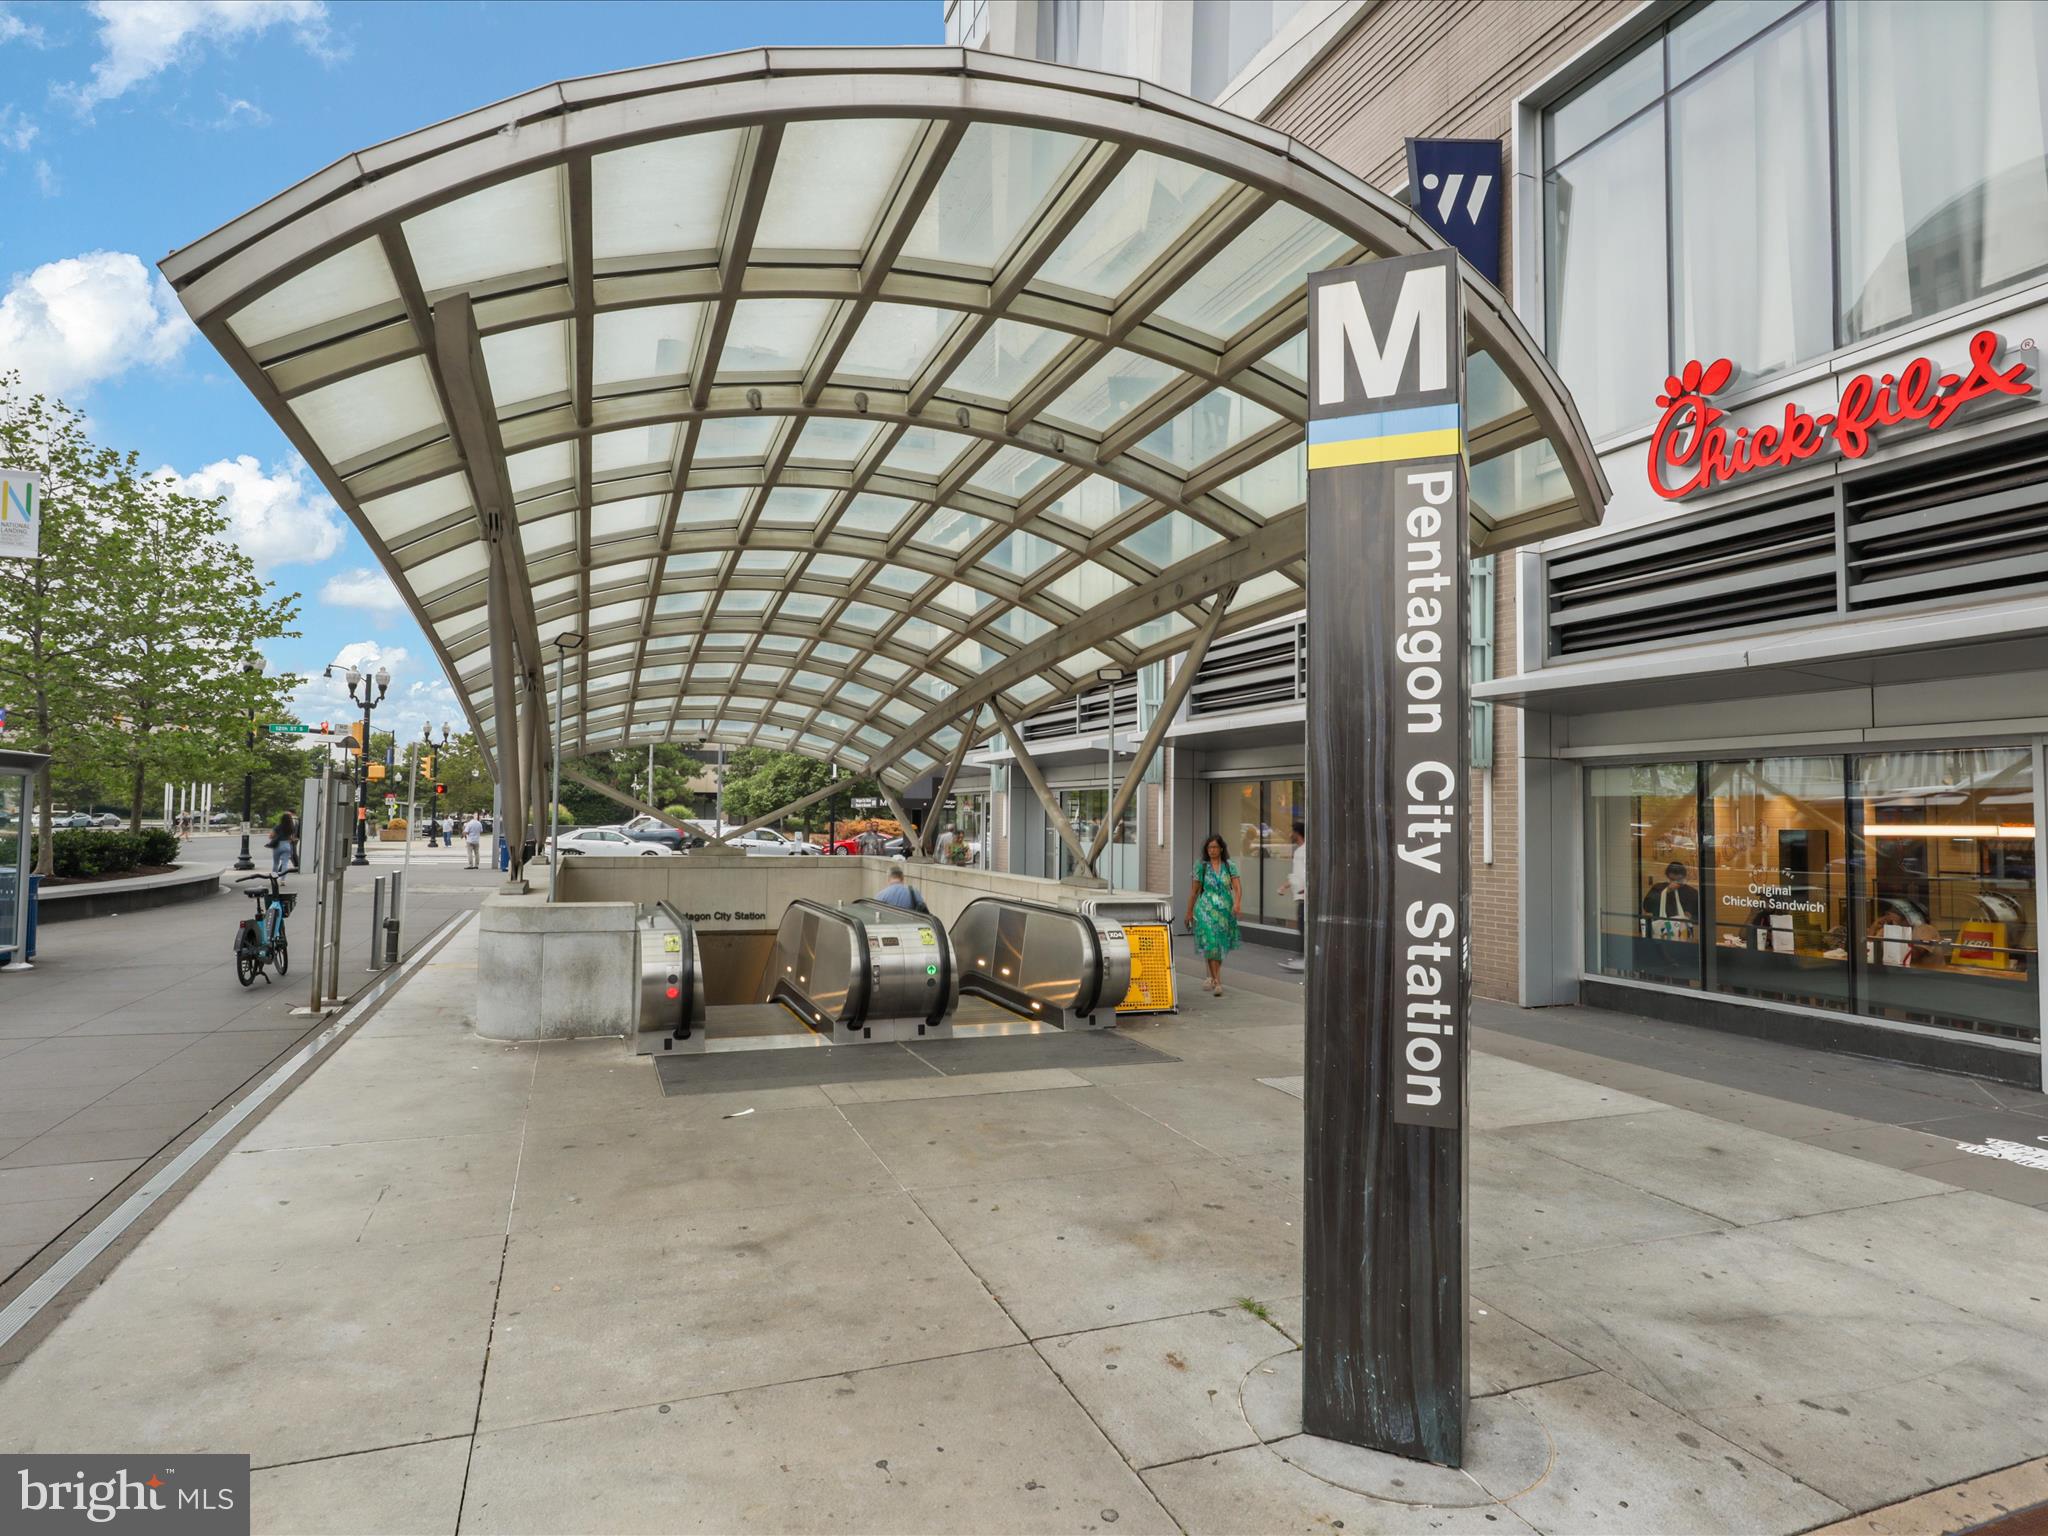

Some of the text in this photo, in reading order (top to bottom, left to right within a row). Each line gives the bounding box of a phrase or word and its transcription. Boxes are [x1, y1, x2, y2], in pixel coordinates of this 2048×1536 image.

[1318, 265, 1447, 405] M
[1647, 331, 2032, 499] Chick-fil-A
[1396, 470, 1455, 1106] Pentagon City Station
[683, 911, 766, 922] tagon City Station
[1722, 895, 1824, 913] Chicken Sandwich
[1748, 883, 1792, 897] Original
